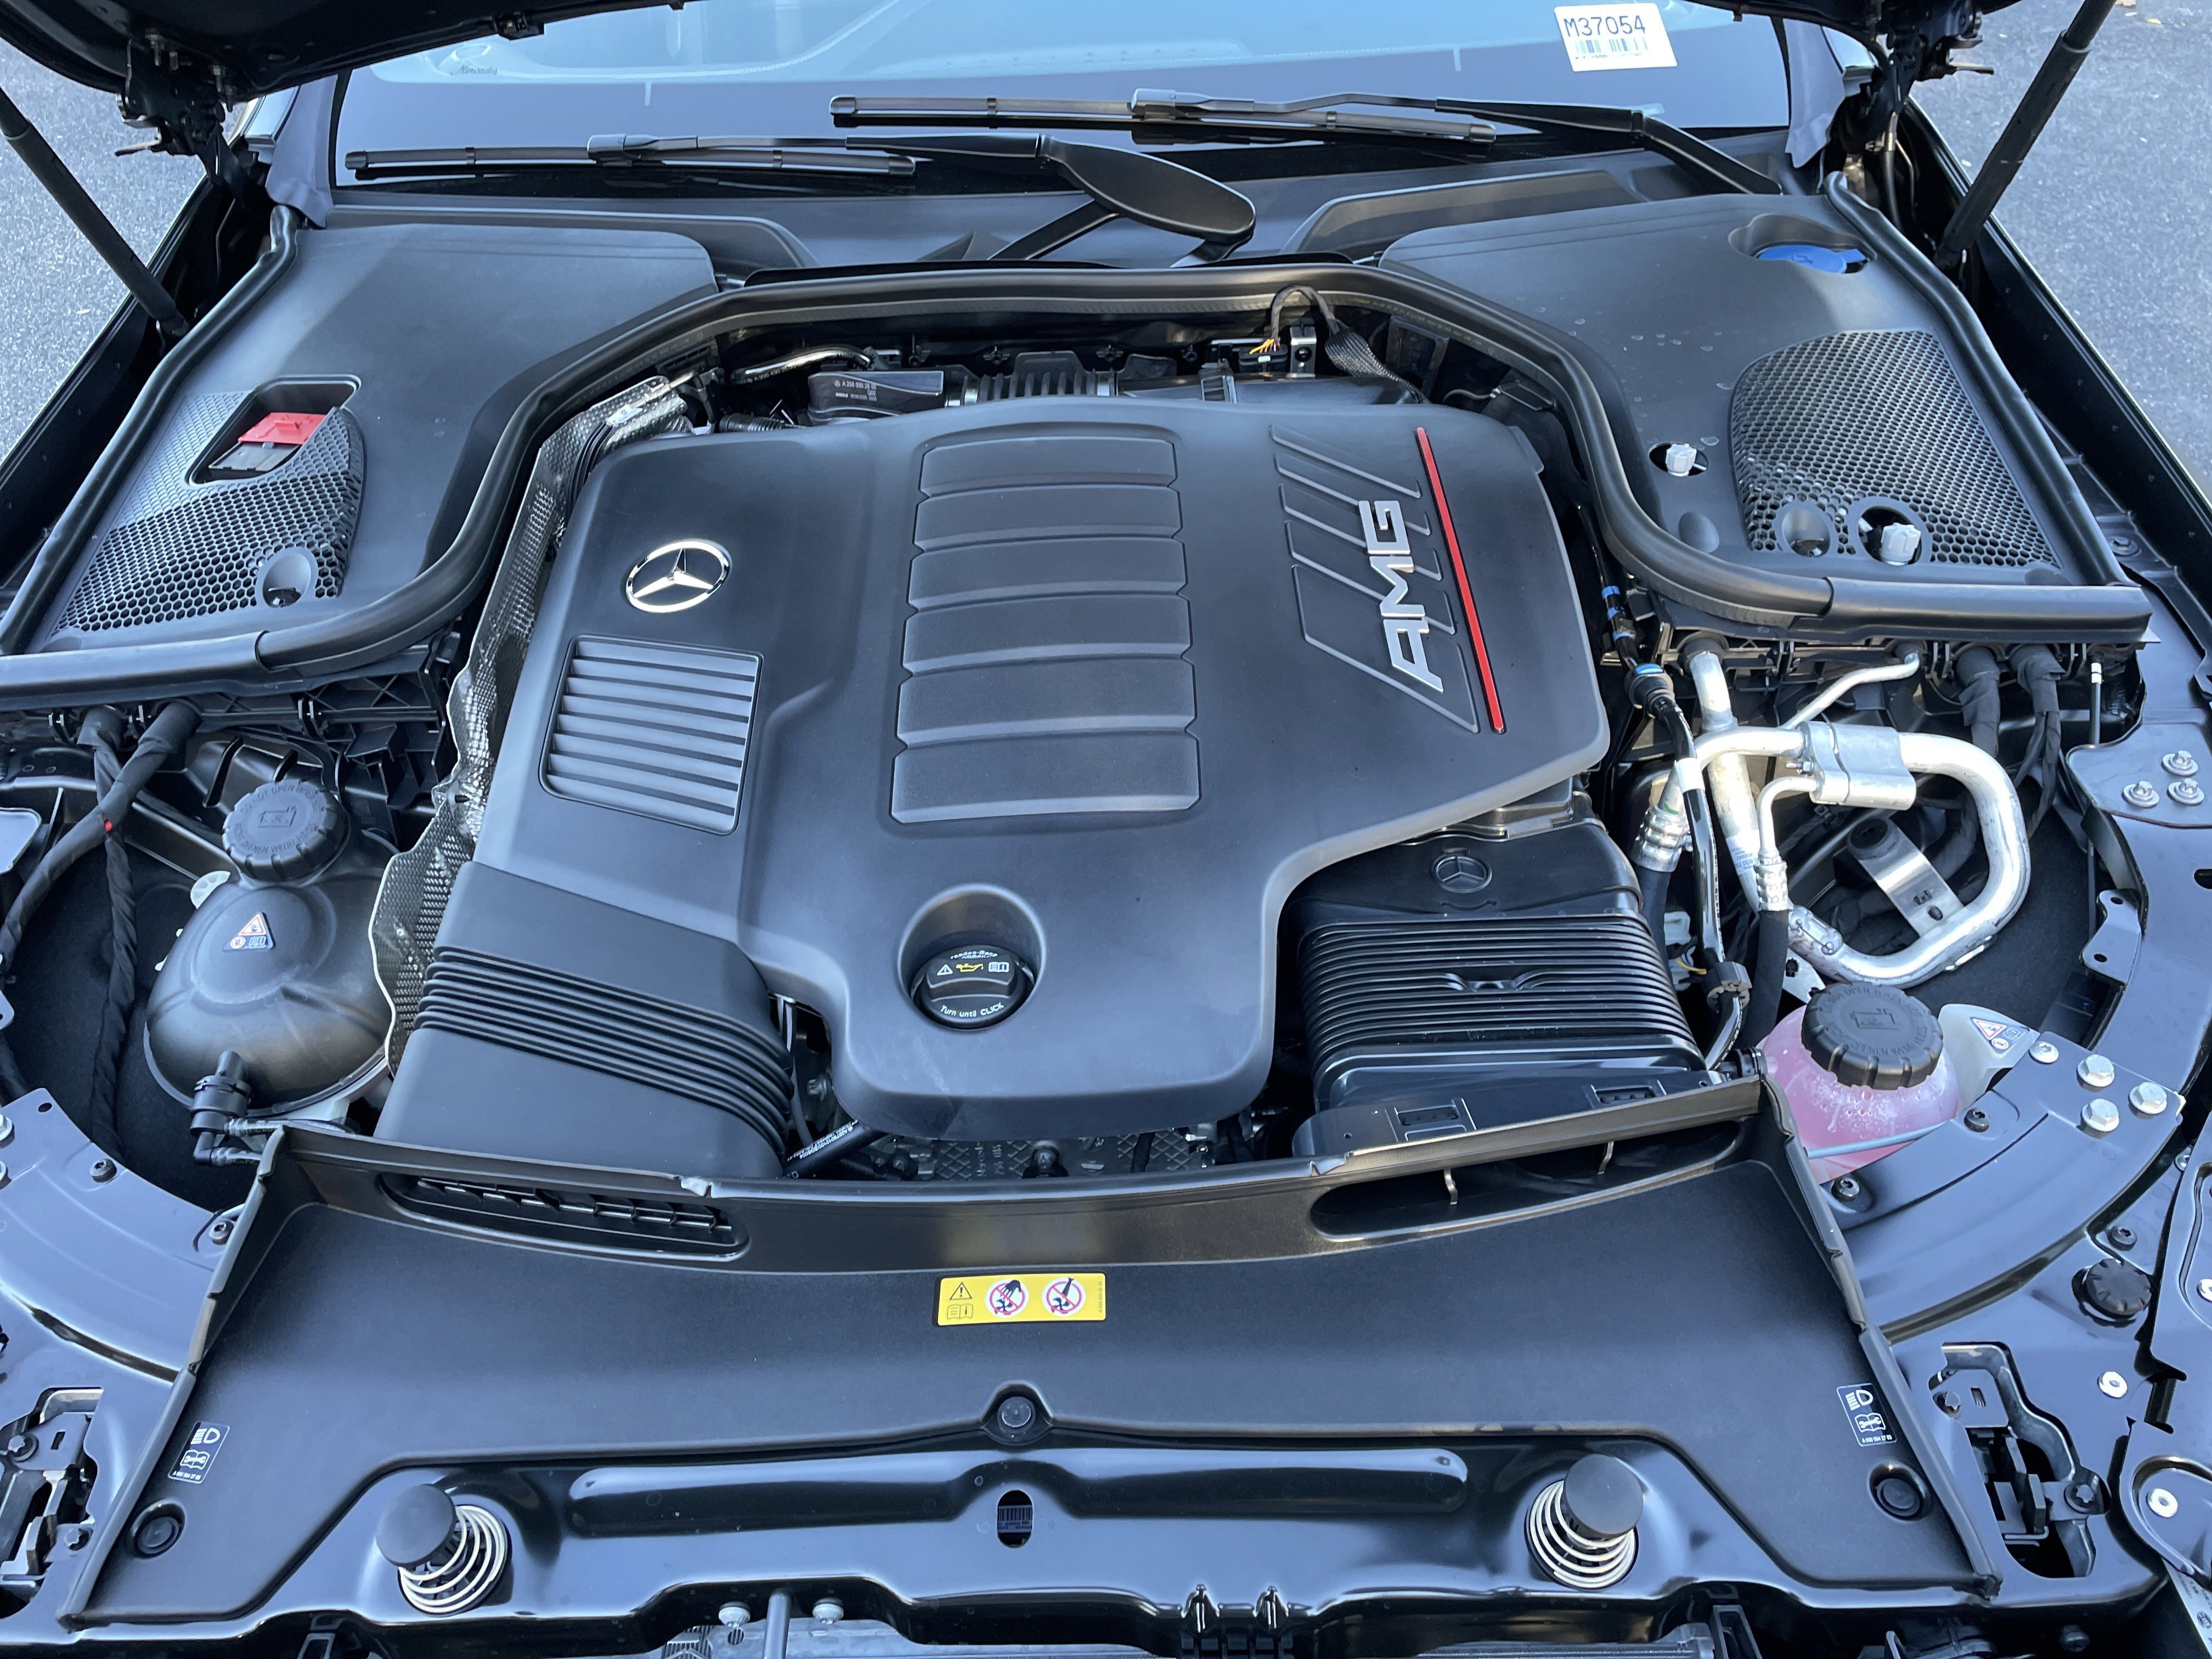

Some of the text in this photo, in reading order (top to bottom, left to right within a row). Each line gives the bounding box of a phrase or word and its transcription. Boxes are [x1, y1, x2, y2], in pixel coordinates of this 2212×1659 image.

[1564, 15, 1646, 37] M37054
[1358, 500, 1443, 692] AMG
[271, 785, 295, 794] OPEN
[940, 1005, 957, 1017] Turn
[980, 1002, 1005, 1016] CLICK
